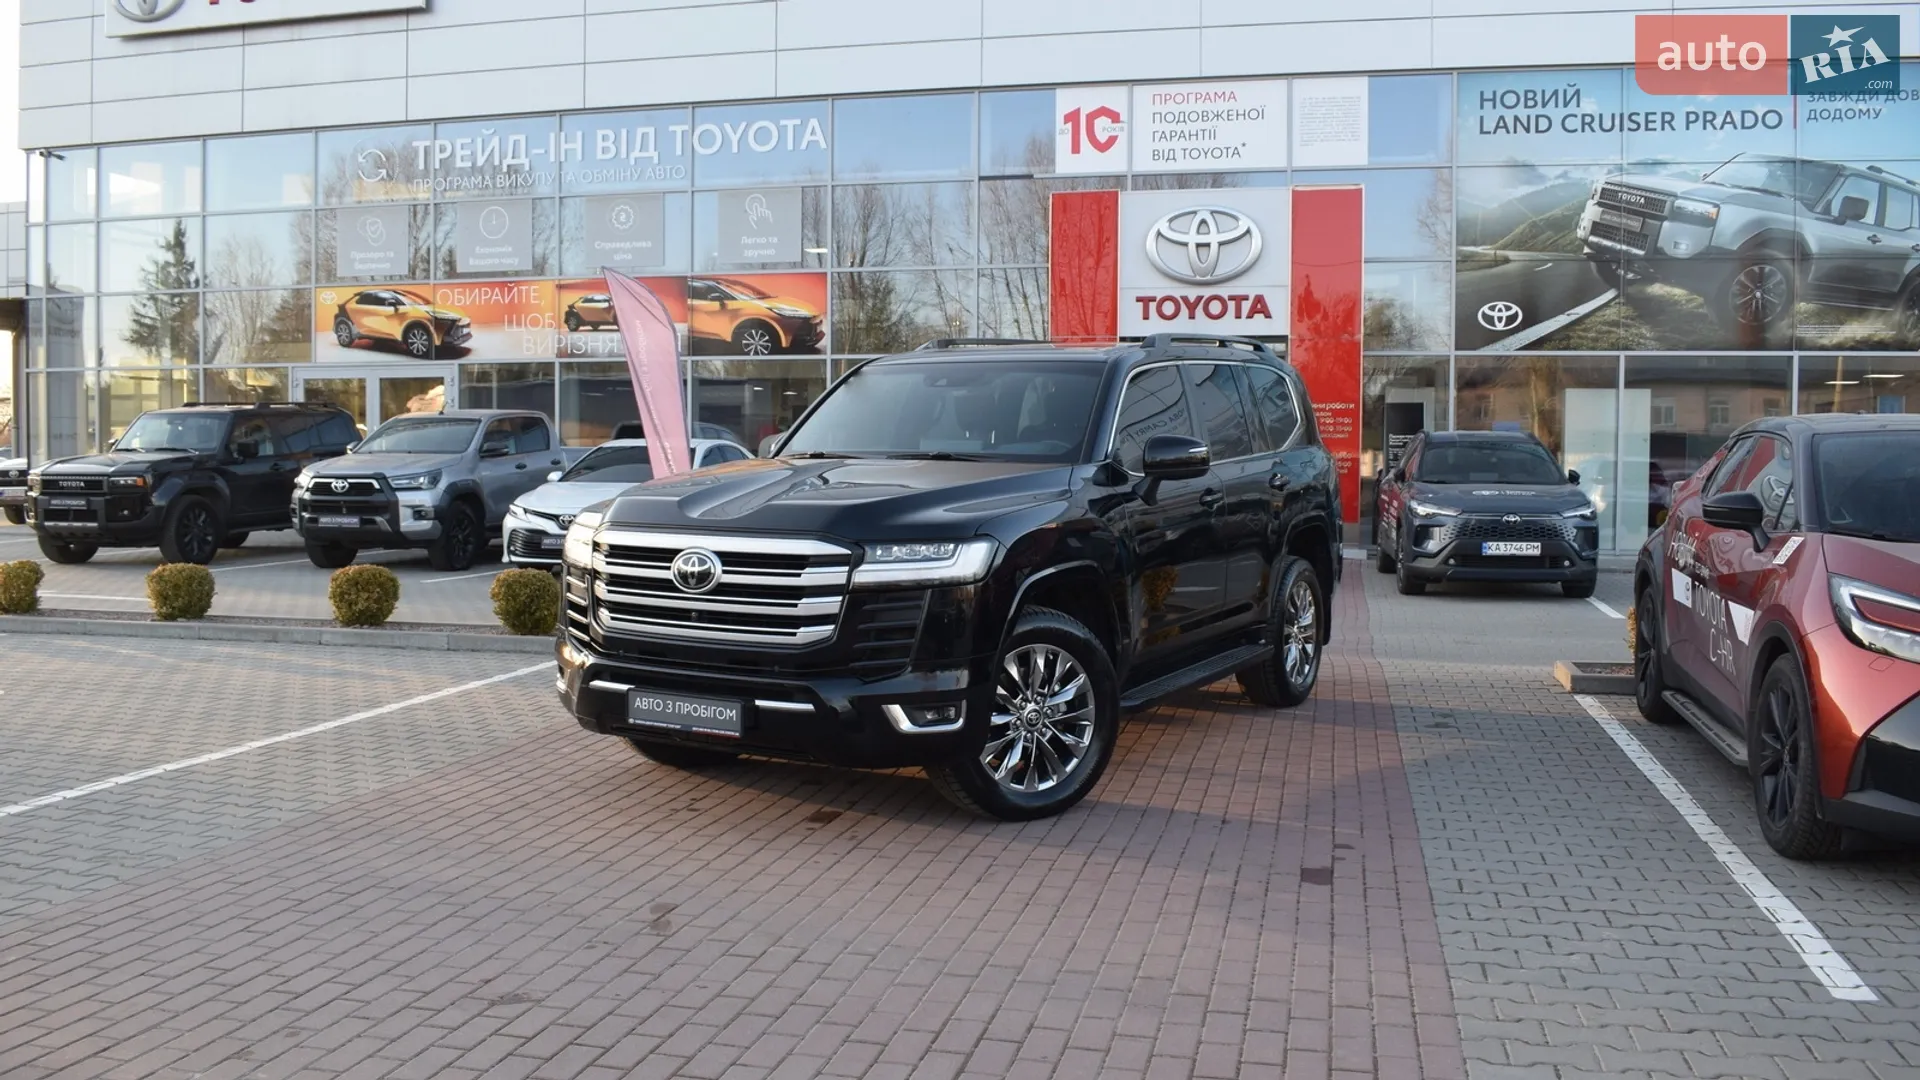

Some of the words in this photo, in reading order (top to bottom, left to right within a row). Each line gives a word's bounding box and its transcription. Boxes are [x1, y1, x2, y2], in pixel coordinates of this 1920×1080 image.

[1152, 90, 1238, 106] ПРОГРАМА
[1479, 83, 1581, 110] НОВИЙ
[1152, 104, 1267, 126] ПОДОВЖЕНОЇ
[1479, 113, 1552, 135] LAND
[1561, 111, 1676, 133] CRUISER
[1685, 109, 1783, 131] PRADO
[1806, 107, 1882, 123] ДОДОМУ
[1152, 124, 1218, 143] ГАРАНТІЇ
[412, 128, 583, 172] ТРЕЙД-ІН
[596, 126, 659, 166] ВІД
[668, 118, 828, 156] TOYOTA
[1152, 148, 1177, 163] ВІД
[413, 175, 492, 193] ПРОГРАМА
[497, 171, 555, 188] ВИКУПУ
[580, 166, 641, 183] ОБМІНУ
[645, 165, 686, 180] АВТО
[1618, 193, 1645, 204] TOYOTA
[741, 236, 767, 245] Легко
[436, 283, 546, 306] ОБИРАЙТЕ,
[1135, 294, 1272, 321] TOYOTA
[504, 313, 556, 333] ЩОБ
[1503, 543, 1524, 552] 3746
[1694, 581, 1728, 633] TOYOTA
[1709, 628, 1736, 676] C-HR
[634, 697, 663, 711] АВТО
[675, 701, 737, 721] ПРОБІГОМ
